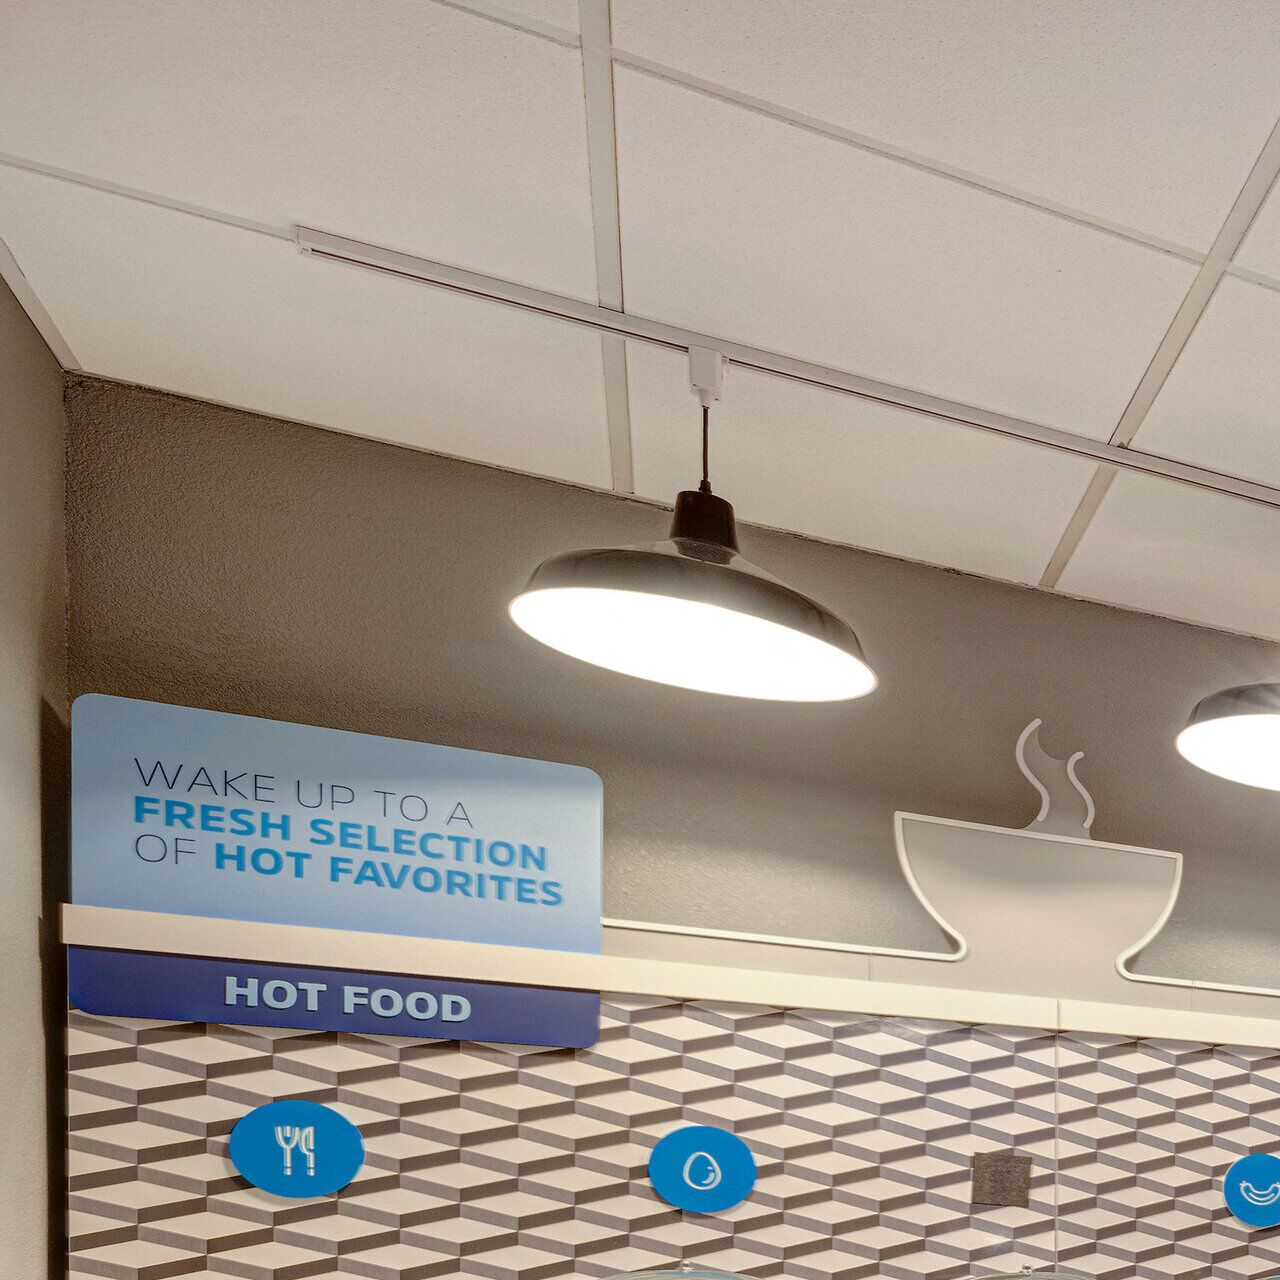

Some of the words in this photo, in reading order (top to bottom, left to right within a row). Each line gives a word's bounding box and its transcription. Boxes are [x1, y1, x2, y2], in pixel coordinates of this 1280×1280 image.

[134, 757, 275, 803] WAKE
[297, 780, 355, 811] UP
[374, 790, 428, 822] TO
[446, 802, 474, 828] A
[134, 795, 291, 842] FRESH
[309, 818, 549, 871] SELECTION
[135, 834, 196, 864] OF
[215, 842, 313, 879] HOT
[330, 856, 564, 906] FAVORITES
[224, 976, 327, 1012] HOT
[343, 985, 472, 1023] FOOD
